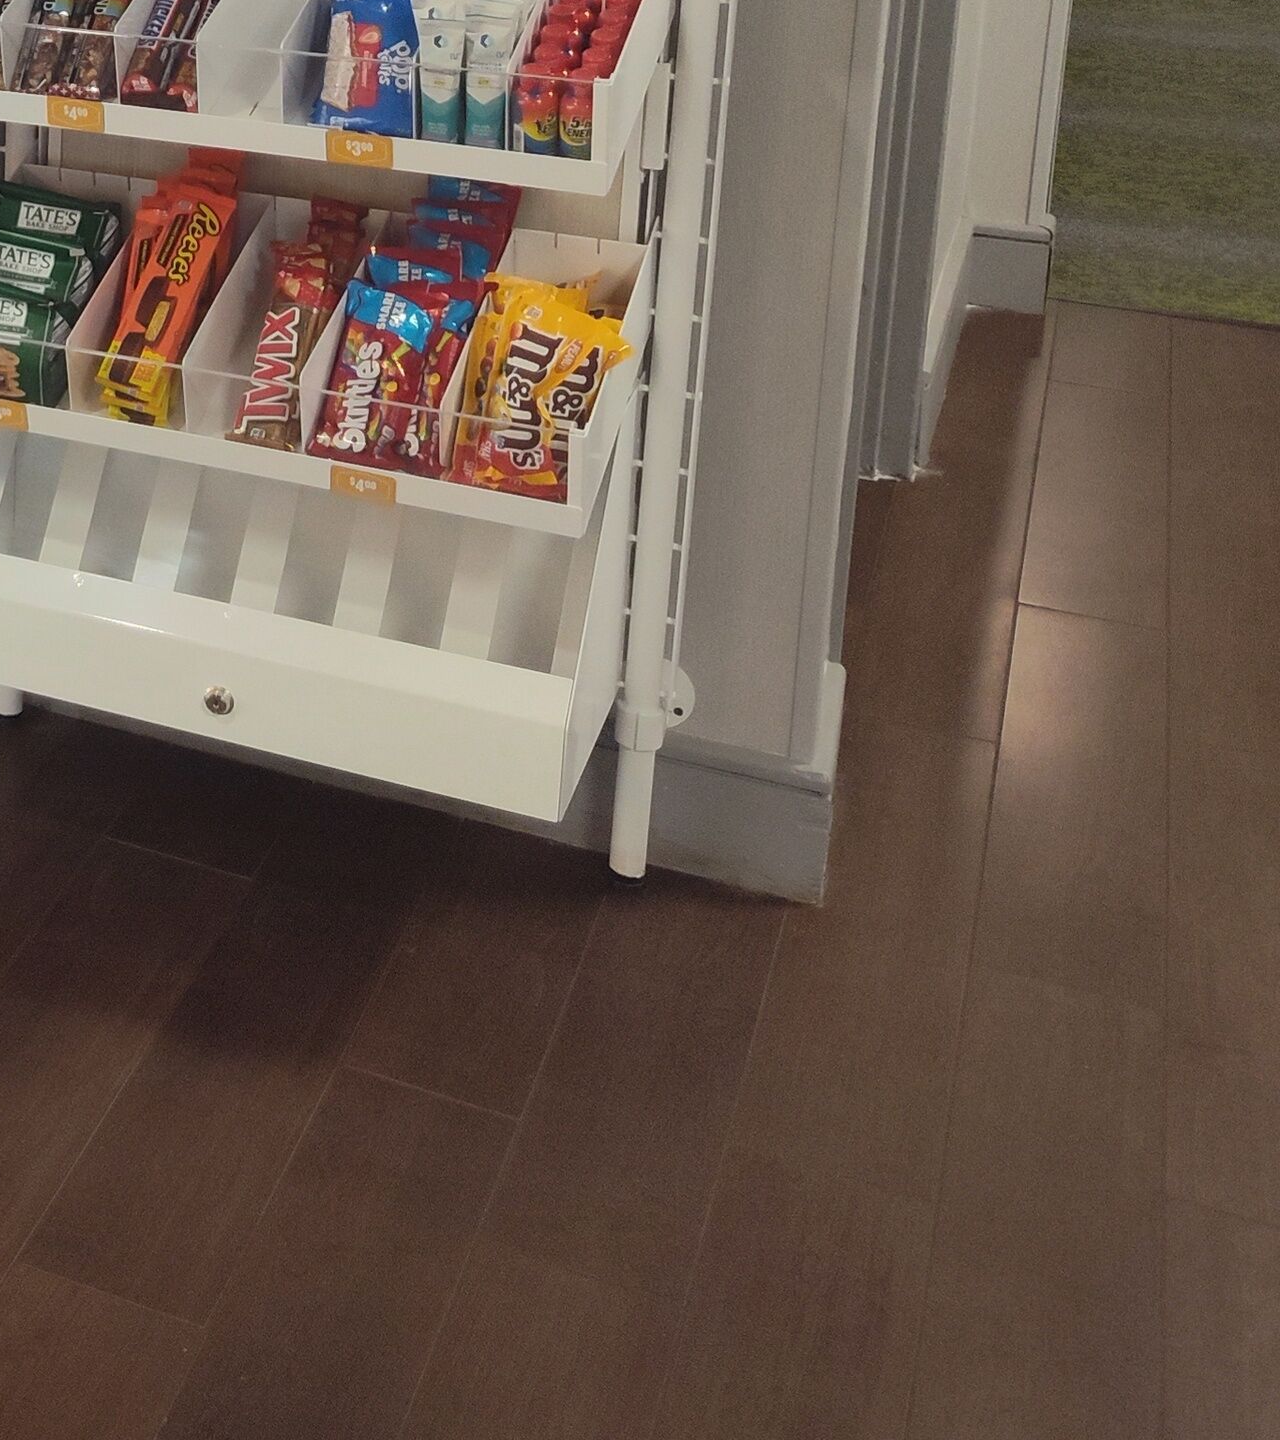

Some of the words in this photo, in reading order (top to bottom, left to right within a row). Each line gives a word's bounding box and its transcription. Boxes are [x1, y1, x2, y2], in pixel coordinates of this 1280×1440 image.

[23, 204, 78, 226] TATE'S
[25, 220, 45, 228] BAKE
[48, 223, 70, 232] SHOP
[168, 202, 222, 287] Reese's
[21, 264, 44, 274] SHOP
[376, 292, 396, 331] SHARE
[234, 307, 300, 436] TWIX
[332, 341, 383, 453] Skittles
